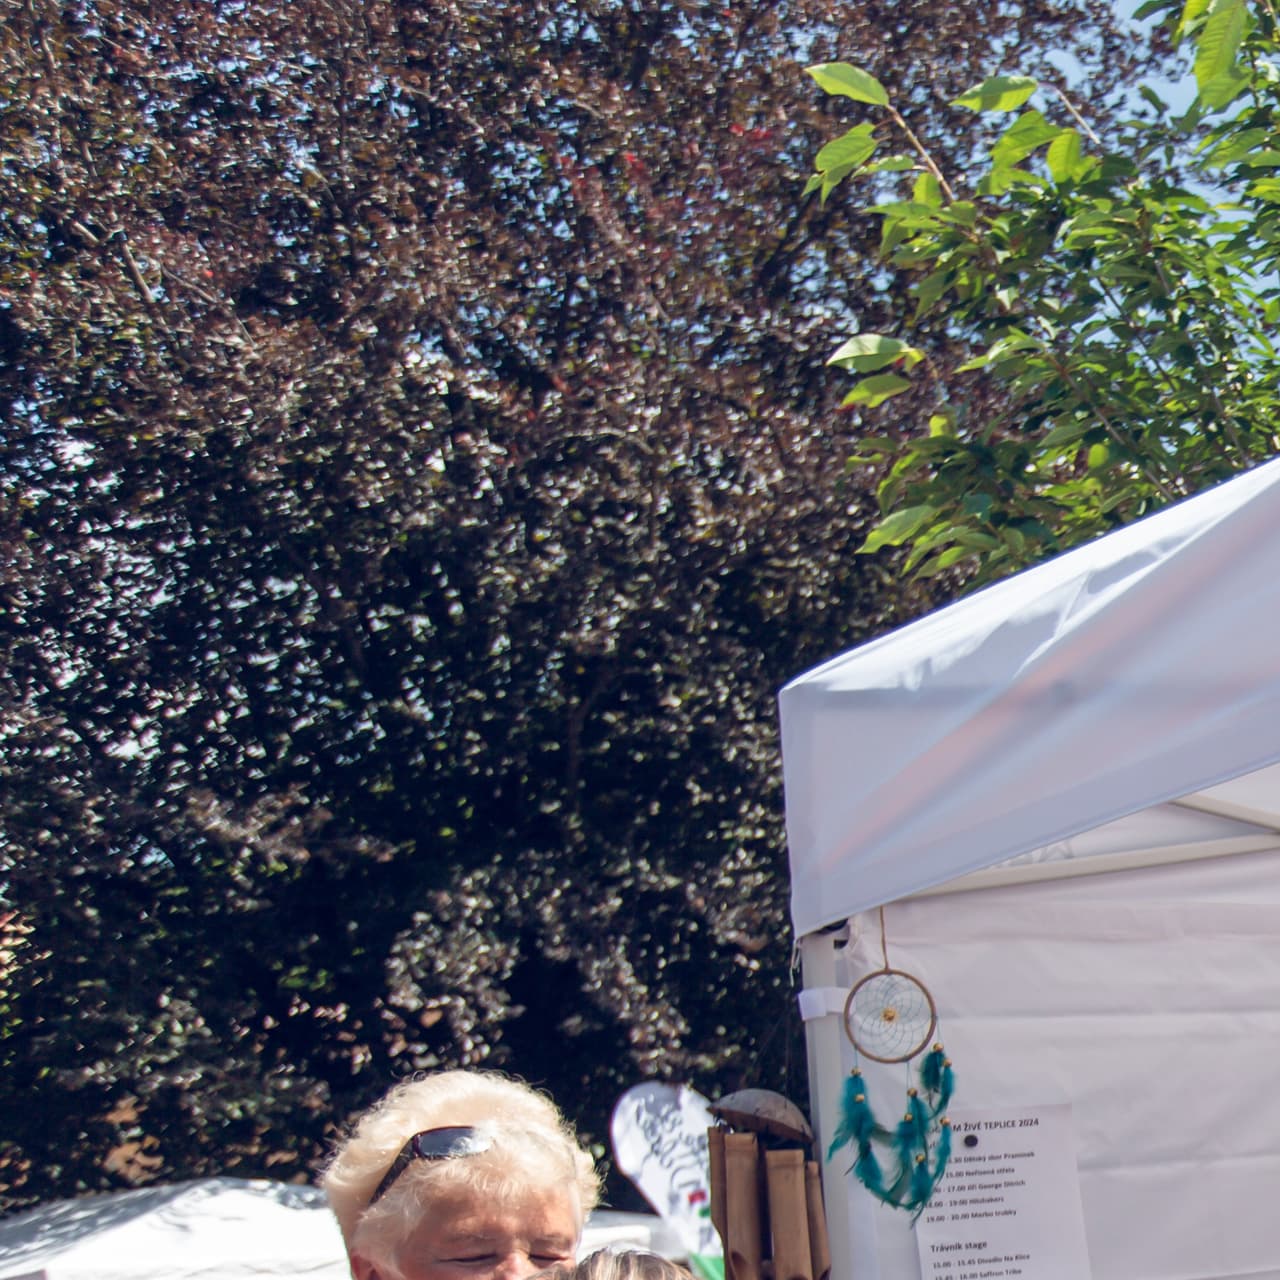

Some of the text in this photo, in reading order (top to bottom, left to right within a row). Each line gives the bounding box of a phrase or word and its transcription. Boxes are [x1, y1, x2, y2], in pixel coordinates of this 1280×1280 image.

[963, 1121, 982, 1132] ŽIVÉ
[984, 1119, 1016, 1131] TEPLICE
[1018, 1117, 1040, 1128] 2024
